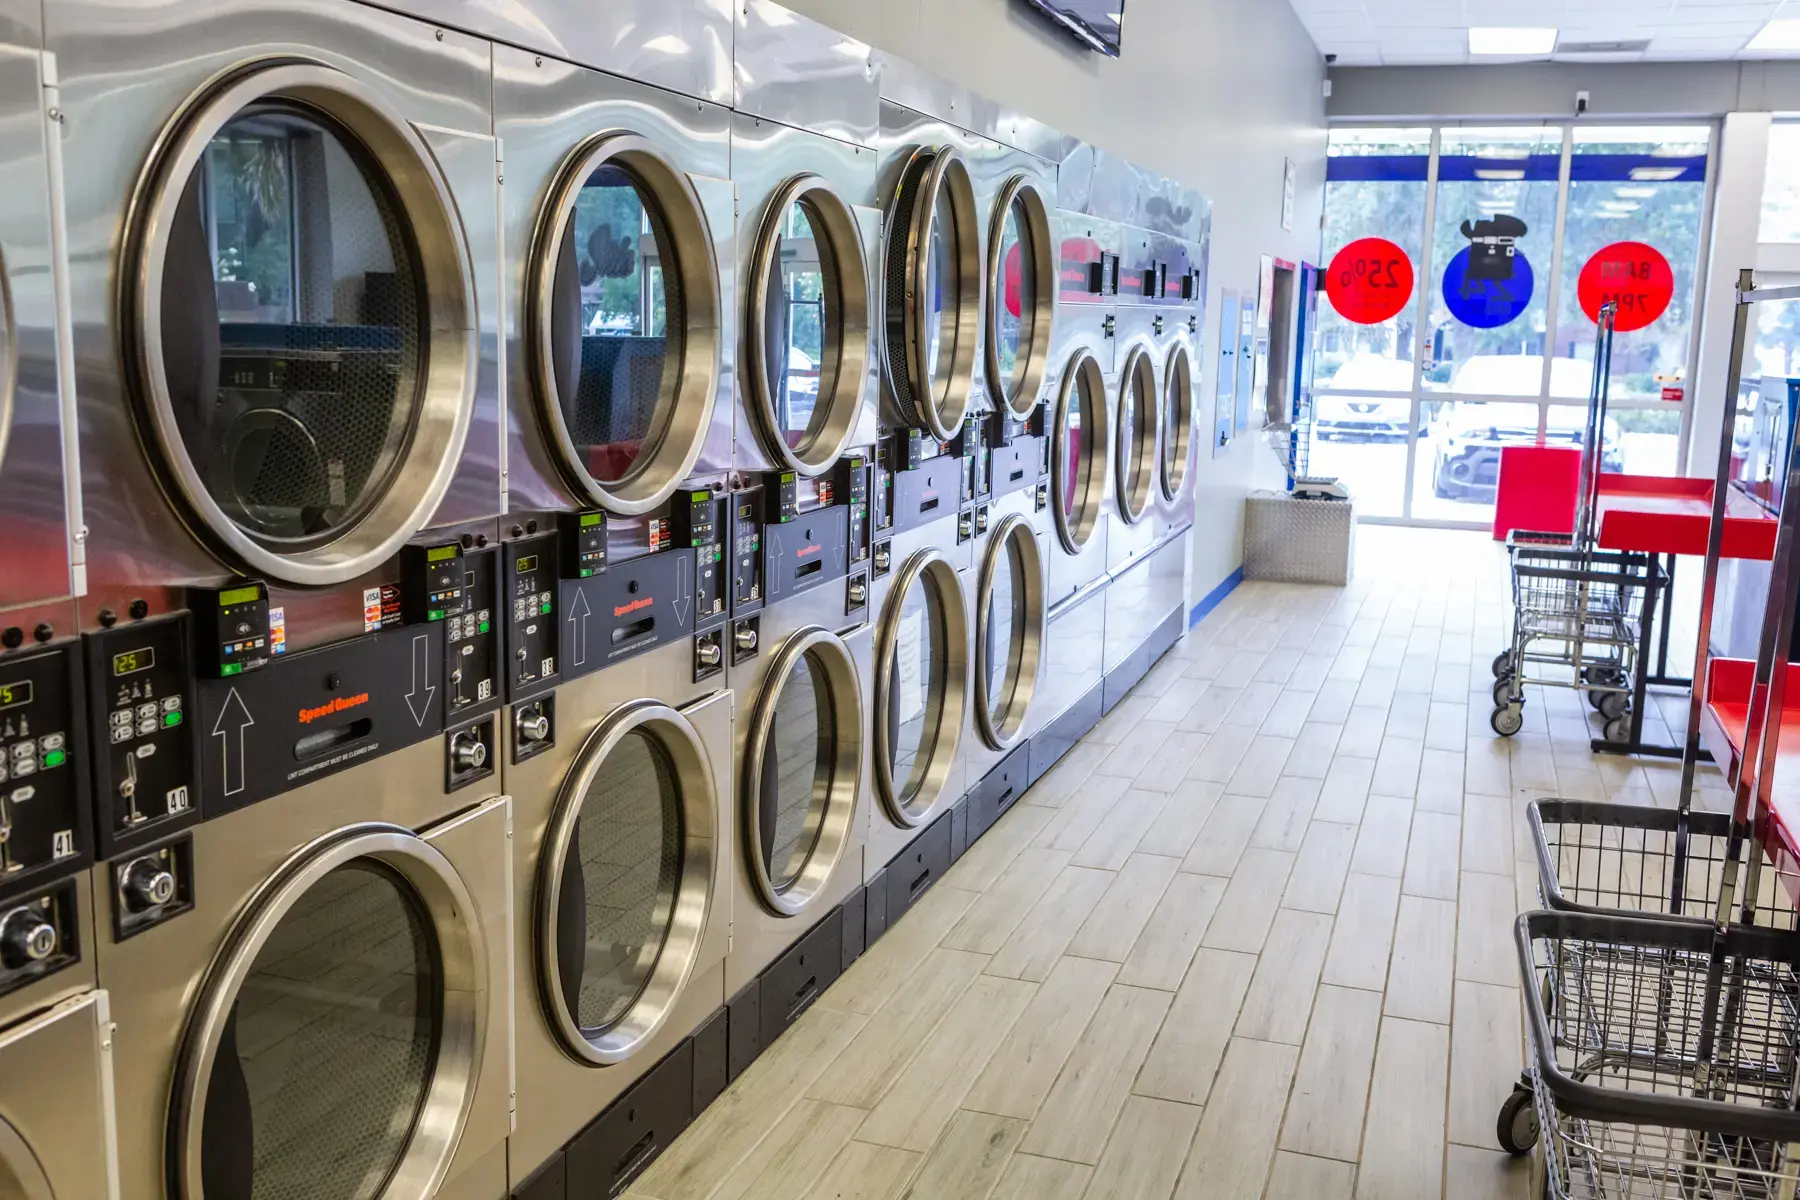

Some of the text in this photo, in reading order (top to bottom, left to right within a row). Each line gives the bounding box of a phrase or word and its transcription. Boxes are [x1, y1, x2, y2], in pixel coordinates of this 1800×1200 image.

[365, 591, 380, 602] VISA
[480, 680, 490, 698] 39
[298, 692, 369, 724] Speed Queen
[348, 746, 368, 758] CLEANED
[367, 742, 379, 752] DAILY
[170, 789, 186, 811] 40
[55, 832, 72, 857] 41
